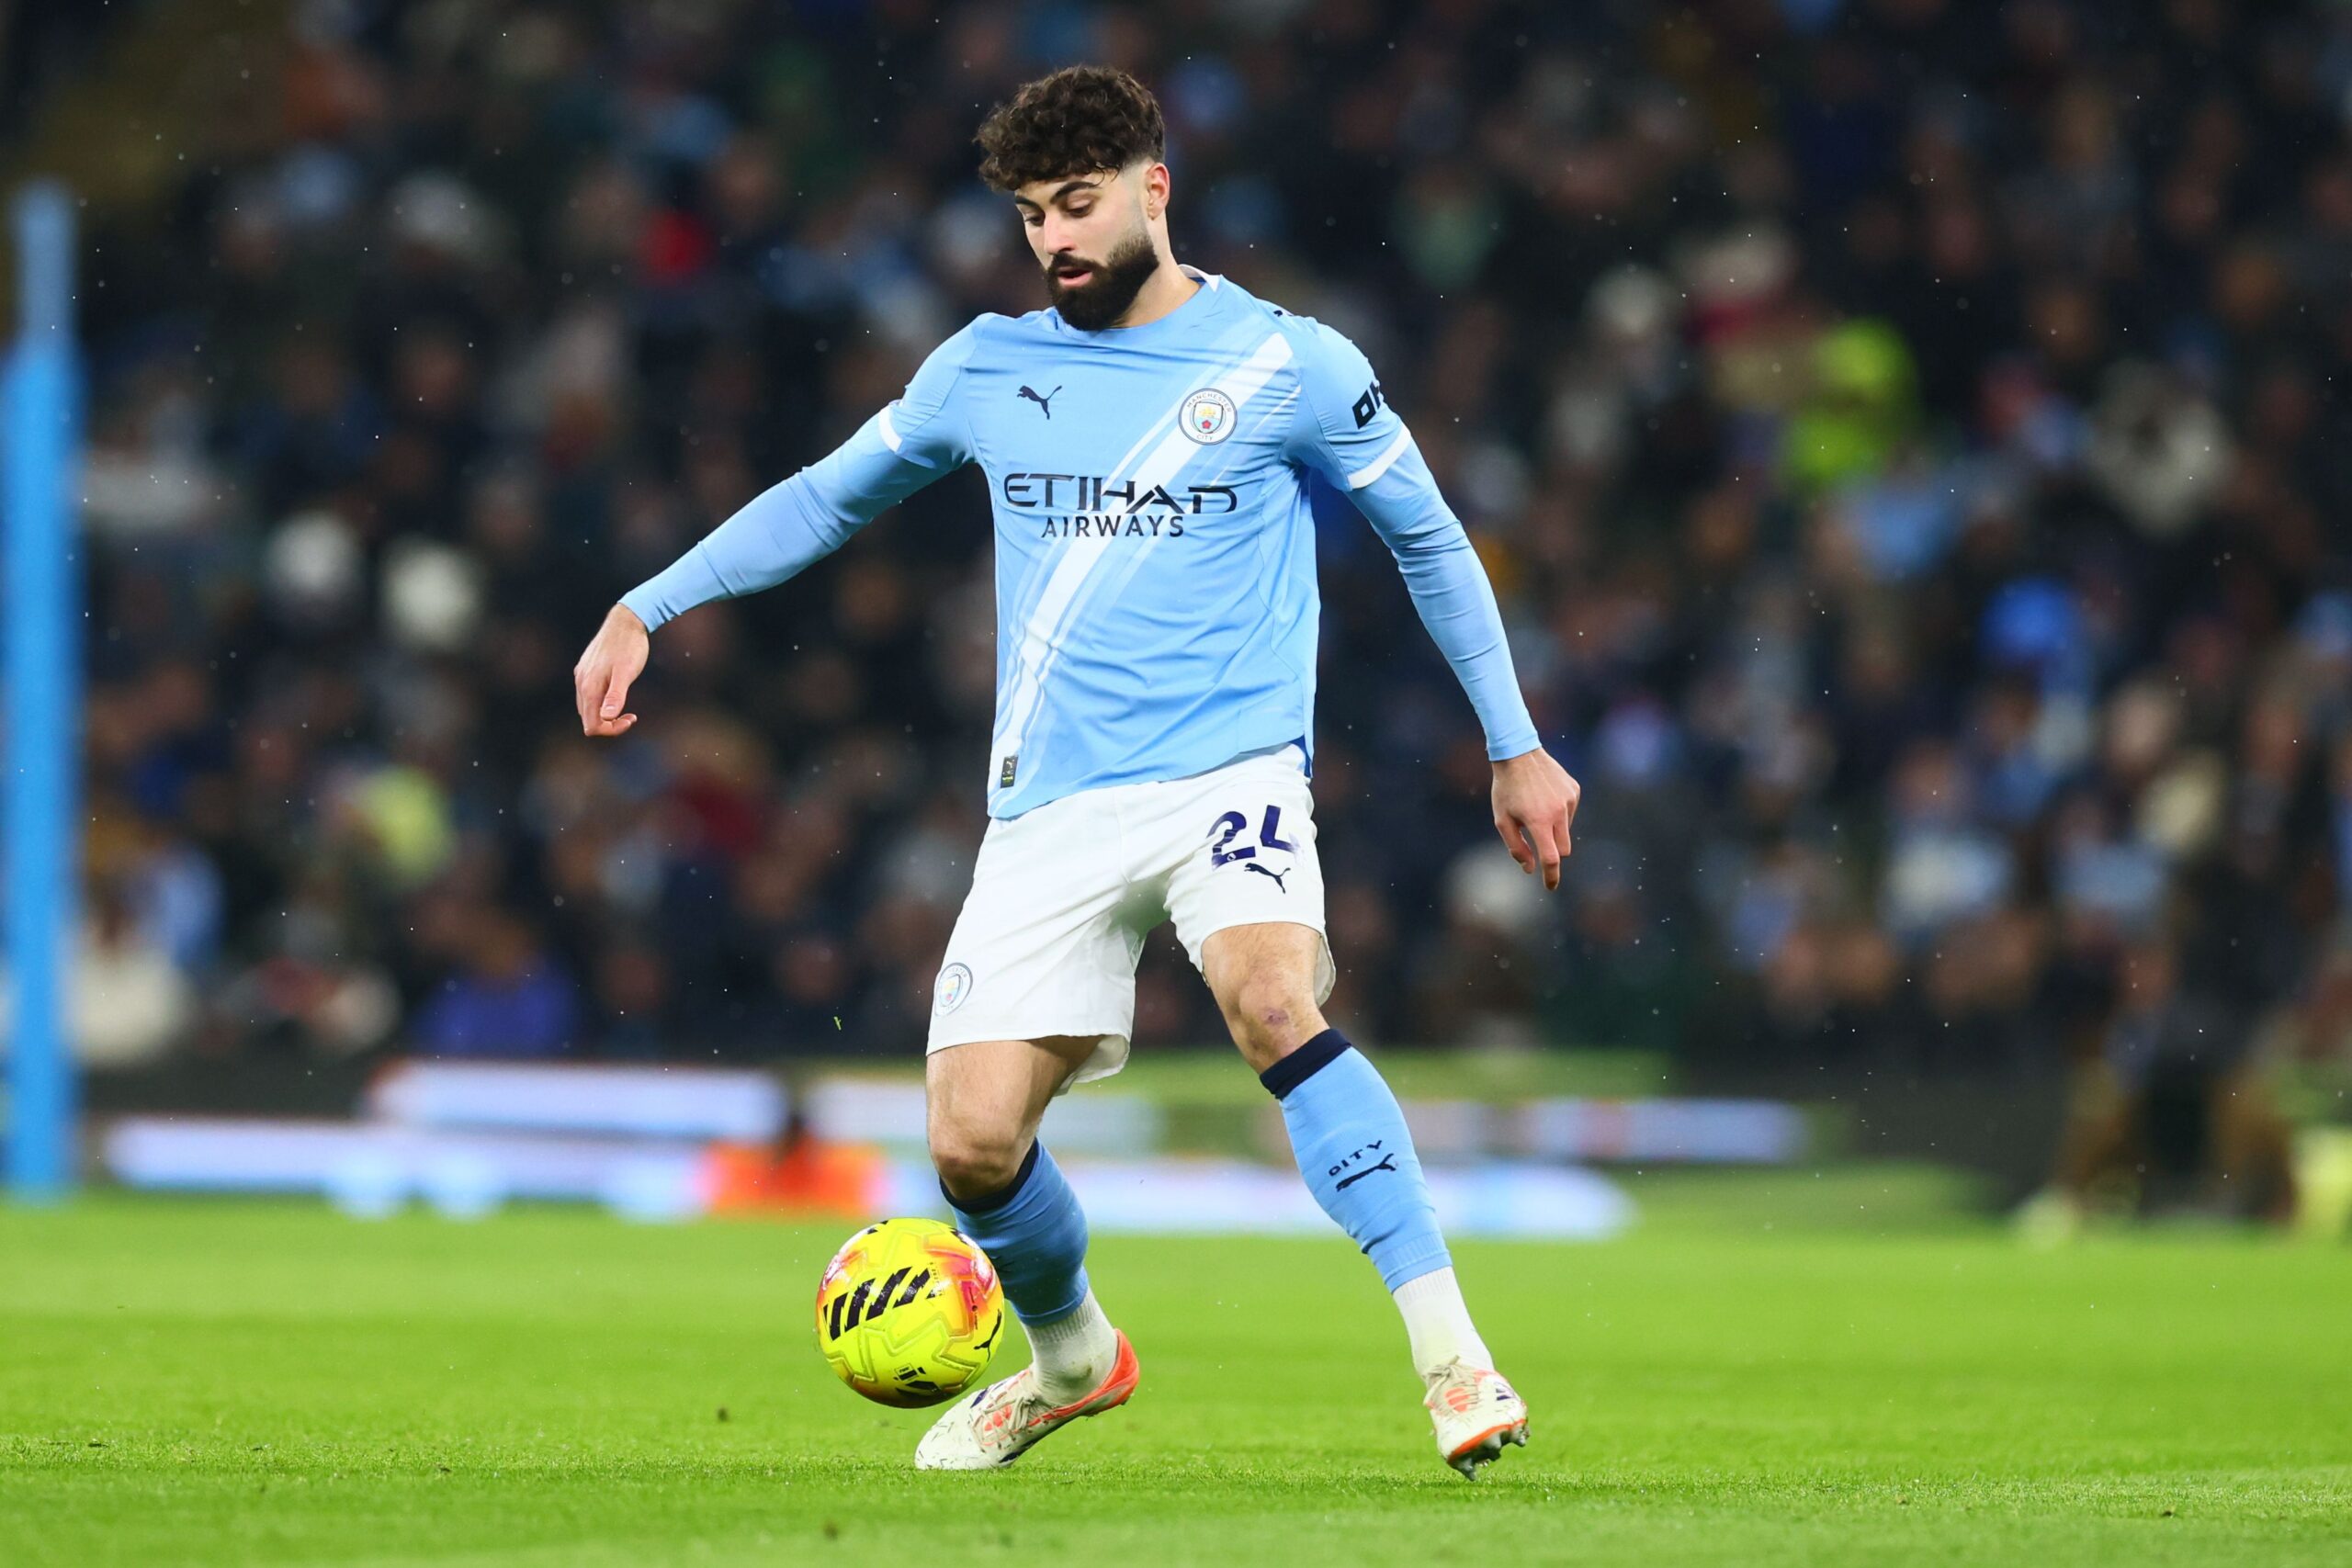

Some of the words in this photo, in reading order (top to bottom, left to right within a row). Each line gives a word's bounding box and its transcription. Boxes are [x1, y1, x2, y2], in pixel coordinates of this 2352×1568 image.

[1187, 392, 1232, 412] MANCHESTER
[1004, 473, 1238, 513] ETIHAD
[1041, 515, 1184, 537] AIRWAYS
[1206, 805, 1298, 871] 24
[1329, 1140, 1382, 1176] CITY
